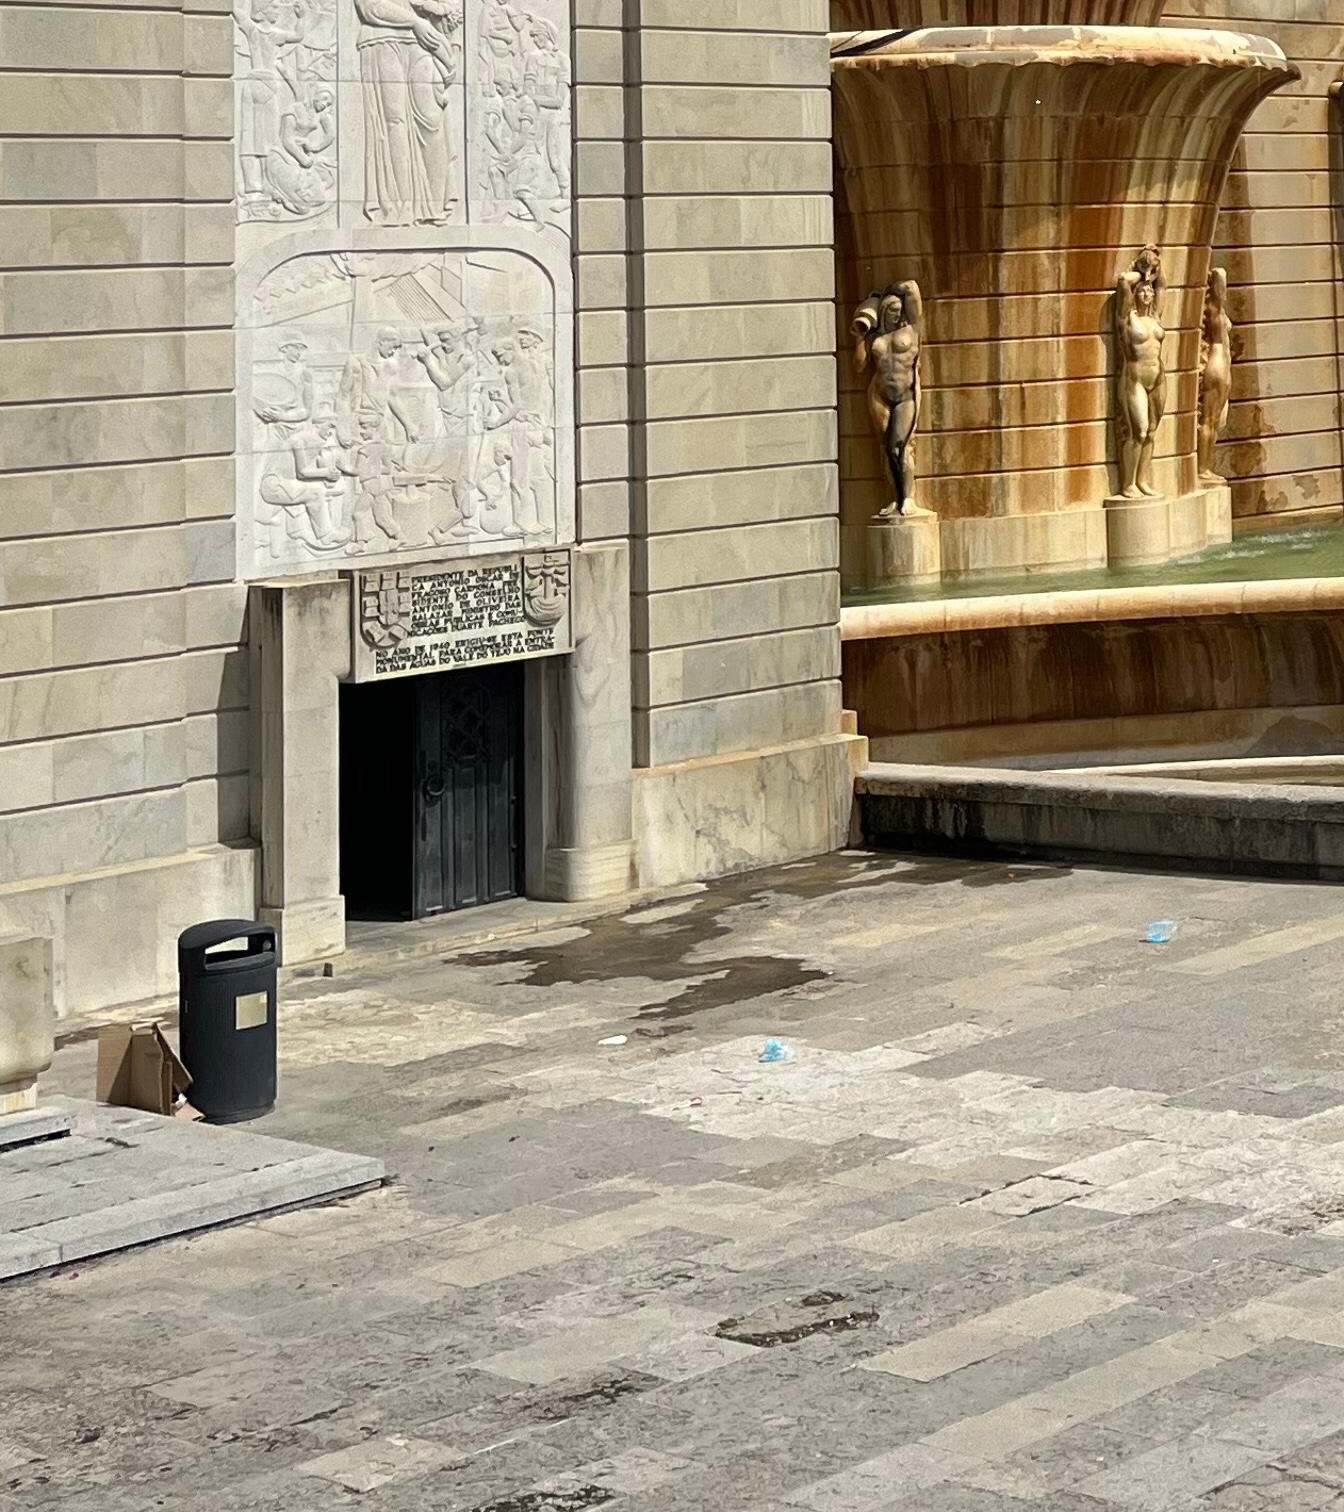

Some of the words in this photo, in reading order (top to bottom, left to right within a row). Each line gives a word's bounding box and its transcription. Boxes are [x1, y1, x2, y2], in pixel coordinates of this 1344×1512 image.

[412, 603, 453, 613] ANTONIO
[476, 594, 519, 605] OLIVEIRA
[430, 642, 449, 650] 1940
[501, 632, 522, 640] ESTA
[439, 648, 461, 656] PARA
